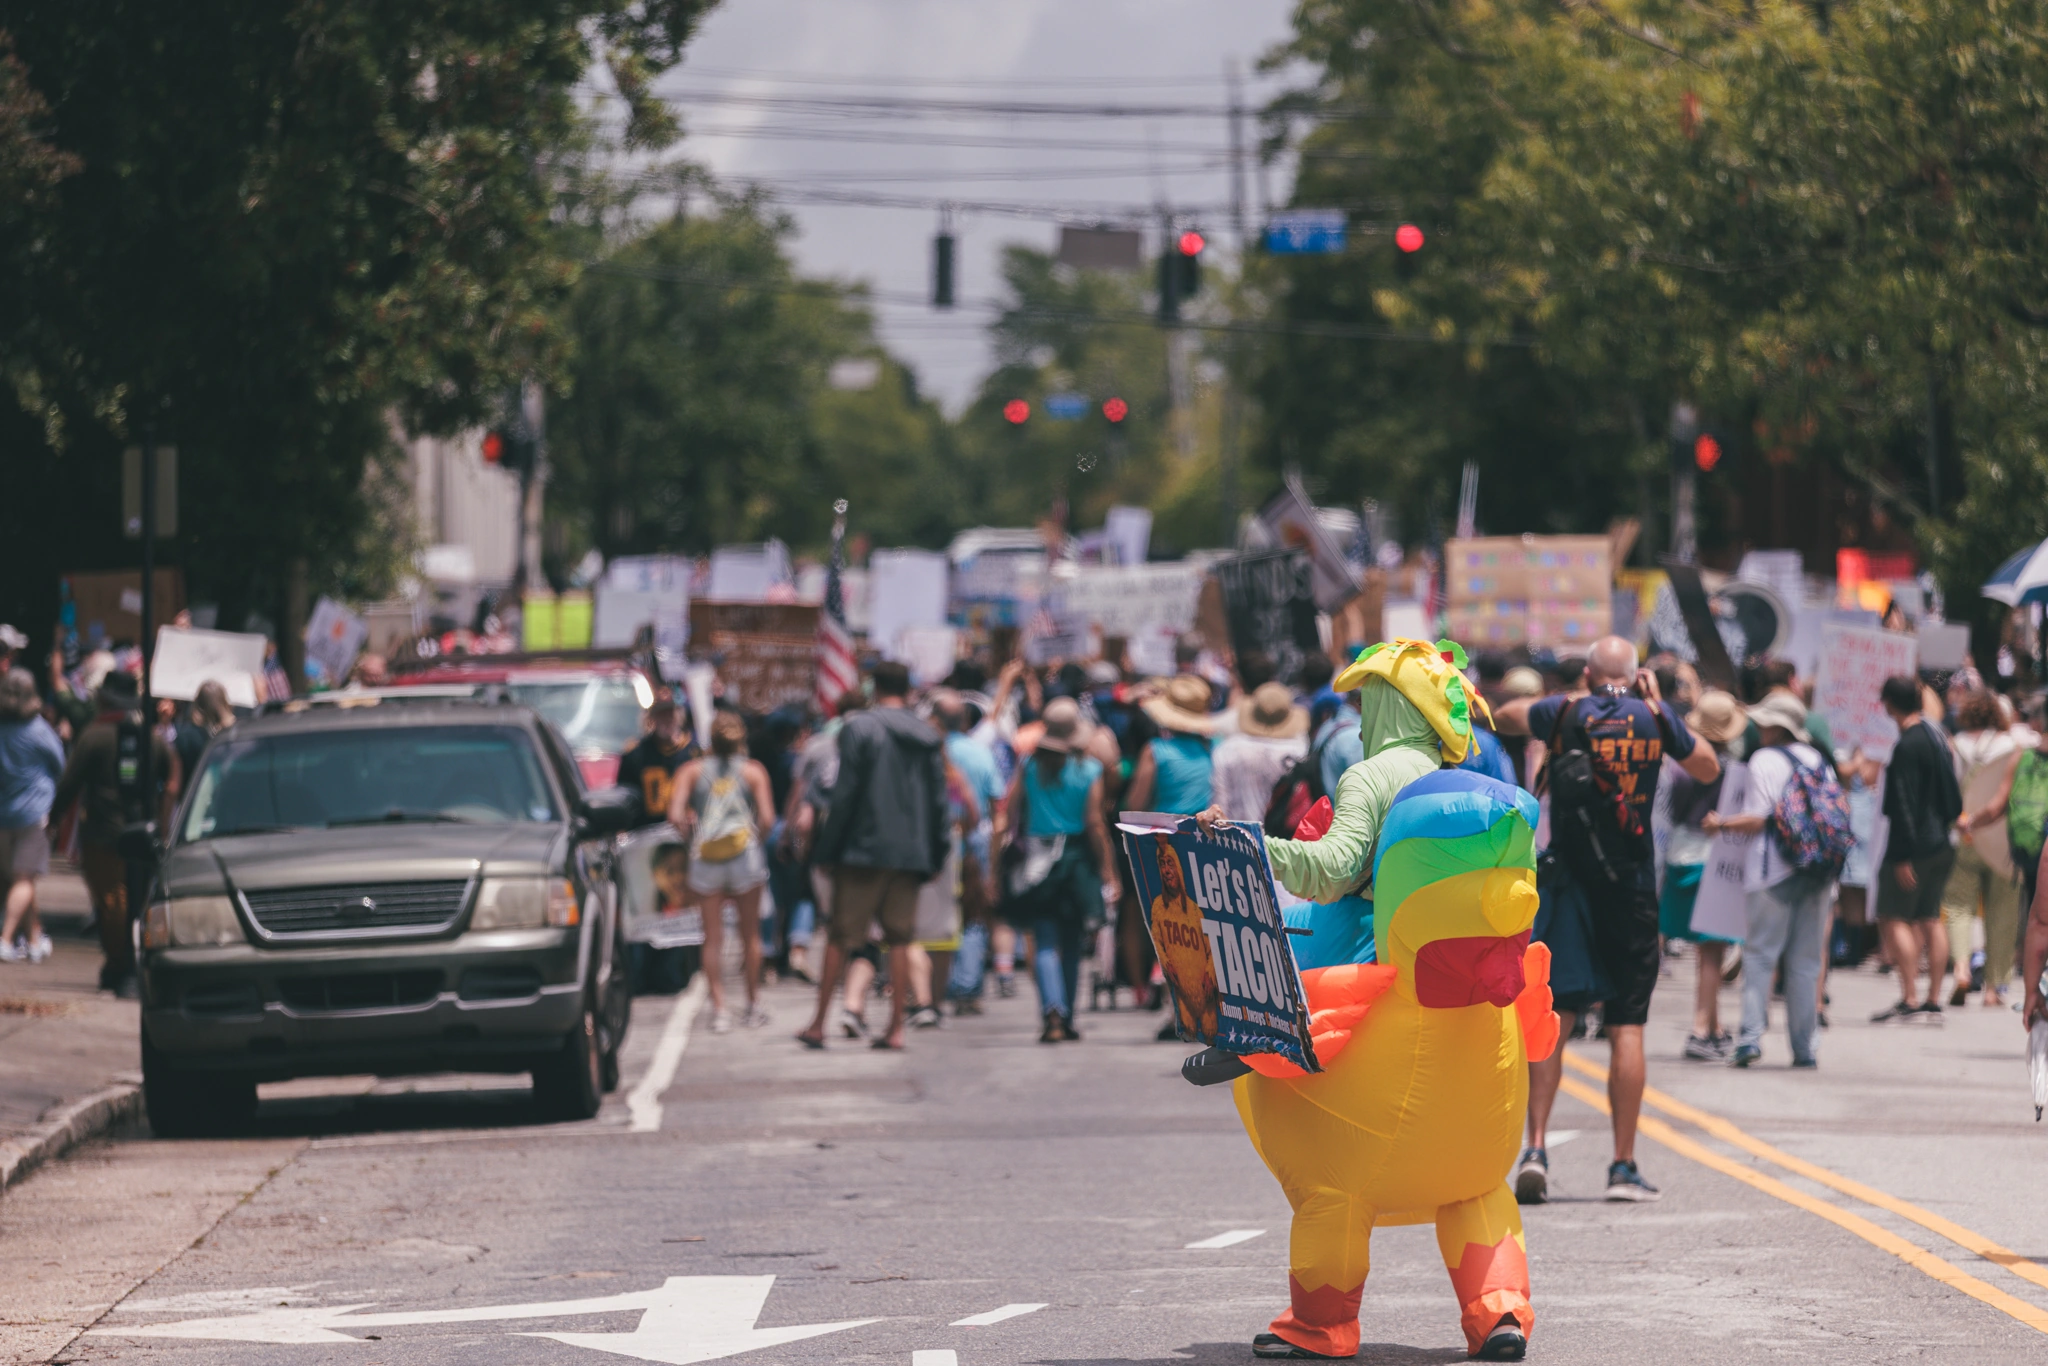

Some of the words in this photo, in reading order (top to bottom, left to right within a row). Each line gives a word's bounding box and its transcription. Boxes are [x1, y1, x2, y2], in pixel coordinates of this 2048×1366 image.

[1188, 851, 1250, 918] Let's
[1163, 920, 1199, 951] TACO
[1200, 918, 1294, 1014] TACO!
